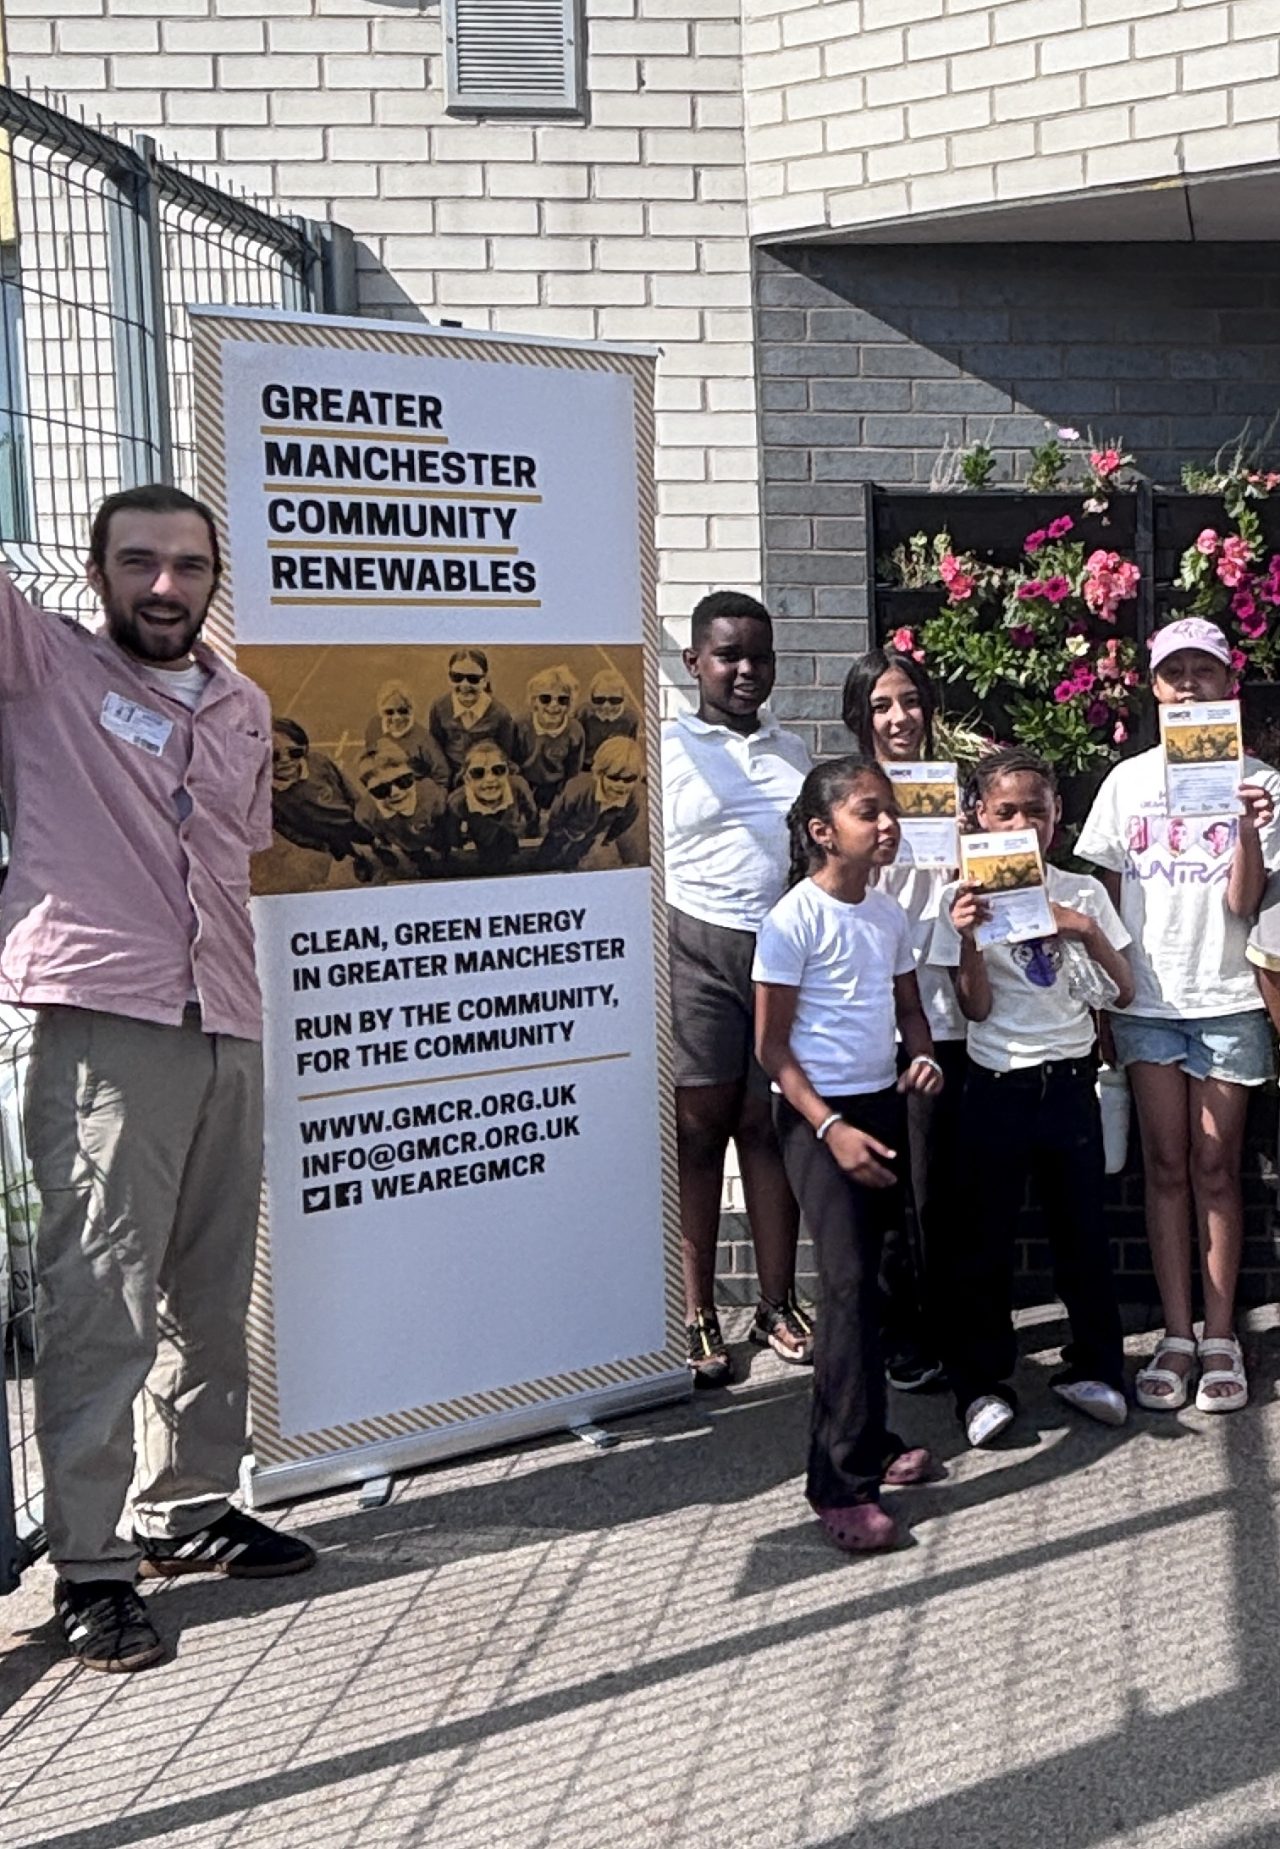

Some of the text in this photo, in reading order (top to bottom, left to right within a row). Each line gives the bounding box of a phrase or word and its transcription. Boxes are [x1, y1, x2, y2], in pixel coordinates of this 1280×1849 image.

[262, 384, 442, 429] GREATER
[265, 442, 536, 488] MANCHESTER
[268, 499, 516, 539] COMMUNITY
[272, 556, 536, 593] RENEWABLES
[291, 909, 585, 956] CLEAN, GREEN ENERGY
[293, 938, 624, 991] IN GREATER MANCHESTER
[295, 984, 618, 1041] RUN BY THE COMMUNITY,
[297, 1020, 574, 1076] FOR THE COMMUNITY
[300, 1084, 576, 1144] WWW.GMCR.ORG.UK
[302, 1115, 580, 1178] INFO@GMCR.ORG.UK
[372, 1153, 545, 1200] WEAREGMCR
